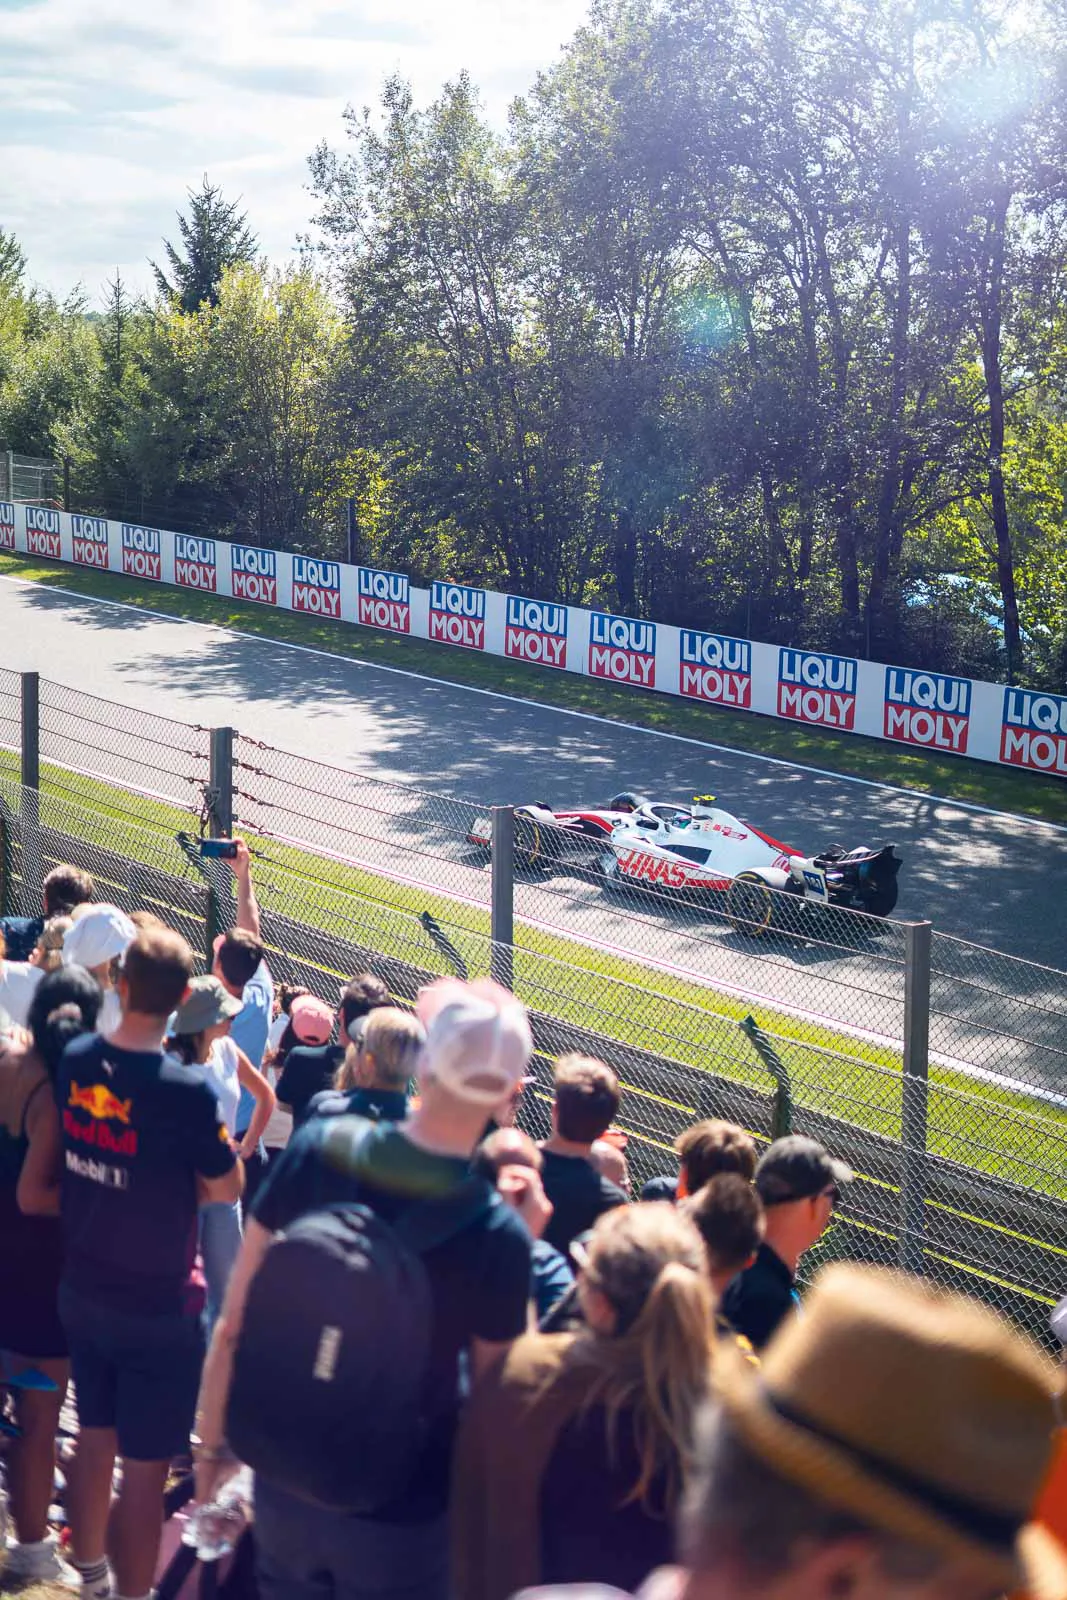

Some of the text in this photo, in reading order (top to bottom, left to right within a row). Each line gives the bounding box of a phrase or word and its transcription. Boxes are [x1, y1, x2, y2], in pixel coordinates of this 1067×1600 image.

[0, 503, 13, 525] UI
[27, 508, 58, 533] LIQUI
[73, 517, 106, 543] LIQUI
[0, 526, 14, 547] LY
[28, 531, 60, 555] MOLY
[123, 526, 159, 553] LIQUI
[176, 536, 215, 565] LIQUI
[73, 540, 107, 567] MOLY
[123, 552, 160, 578] MOLY
[232, 547, 274, 577] LIQUI
[176, 562, 216, 591] MOLY
[232, 573, 276, 602] MOLY
[294, 558, 338, 588] LIQUI
[360, 570, 408, 602] LIQUI
[293, 586, 340, 616] MOLY
[360, 598, 408, 631] MOLY
[432, 584, 483, 617] LIQUI
[508, 598, 565, 635] LIQUI
[431, 613, 484, 647] MOLY
[592, 615, 653, 653] LIQUI
[507, 629, 565, 665] MOLY
[683, 633, 748, 672] LIQUI
[591, 647, 654, 684] MOLY
[782, 651, 854, 692] LIQUI
[683, 665, 750, 704] MOLY
[889, 670, 968, 713] LIQUI
[780, 685, 854, 726] MOLY
[887, 706, 968, 749] MOLY
[617, 848, 686, 889] HAAS
[63, 1108, 138, 1155] Red Bull
[65, 1149, 106, 1185] Mobil
